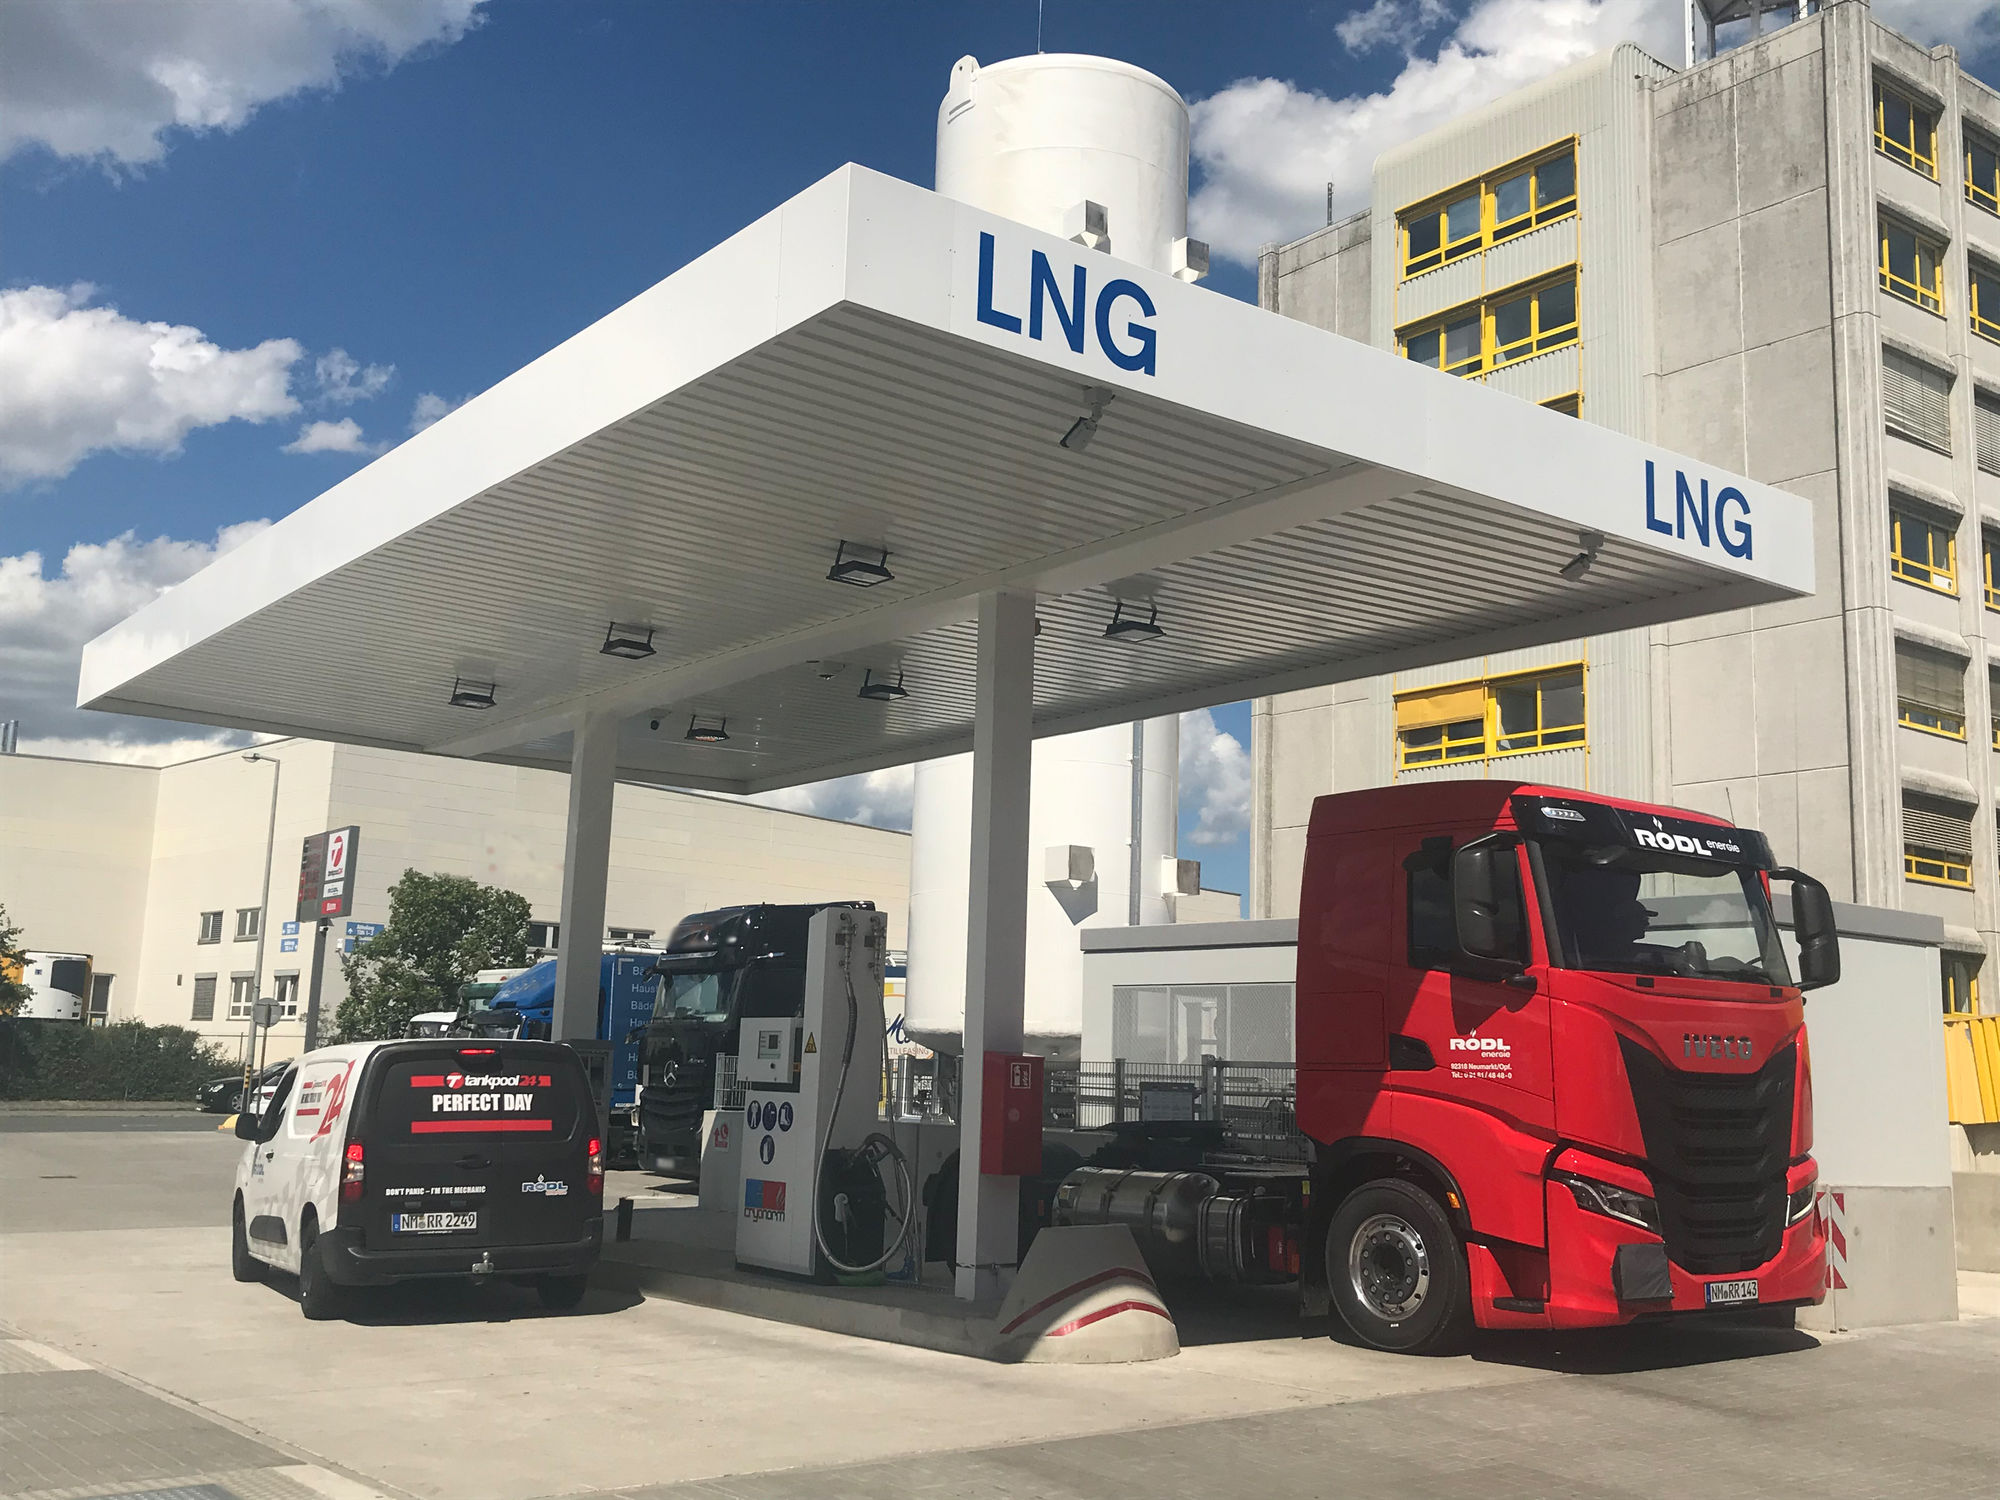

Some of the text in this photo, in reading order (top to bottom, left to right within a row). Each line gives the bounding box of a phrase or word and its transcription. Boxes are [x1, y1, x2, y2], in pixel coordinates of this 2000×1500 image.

[976, 231, 1156, 377] LNG
[1644, 459, 1754, 560] LNG
[1683, 1033, 1753, 1060] IVECO
[432, 1093, 533, 1112] PERFECT DAY
[386, 1188, 404, 1196] DON'T
[405, 1187, 425, 1196] PANIC
[431, 1187, 440, 1195] I'M
[442, 1186, 453, 1194] THE
[454, 1186, 486, 1194] MECHANIC
[402, 1214, 475, 1229] NM RR 2249
[744, 1207, 785, 1222] cryonorm
[1711, 1282, 1757, 1300] NM RR 143
